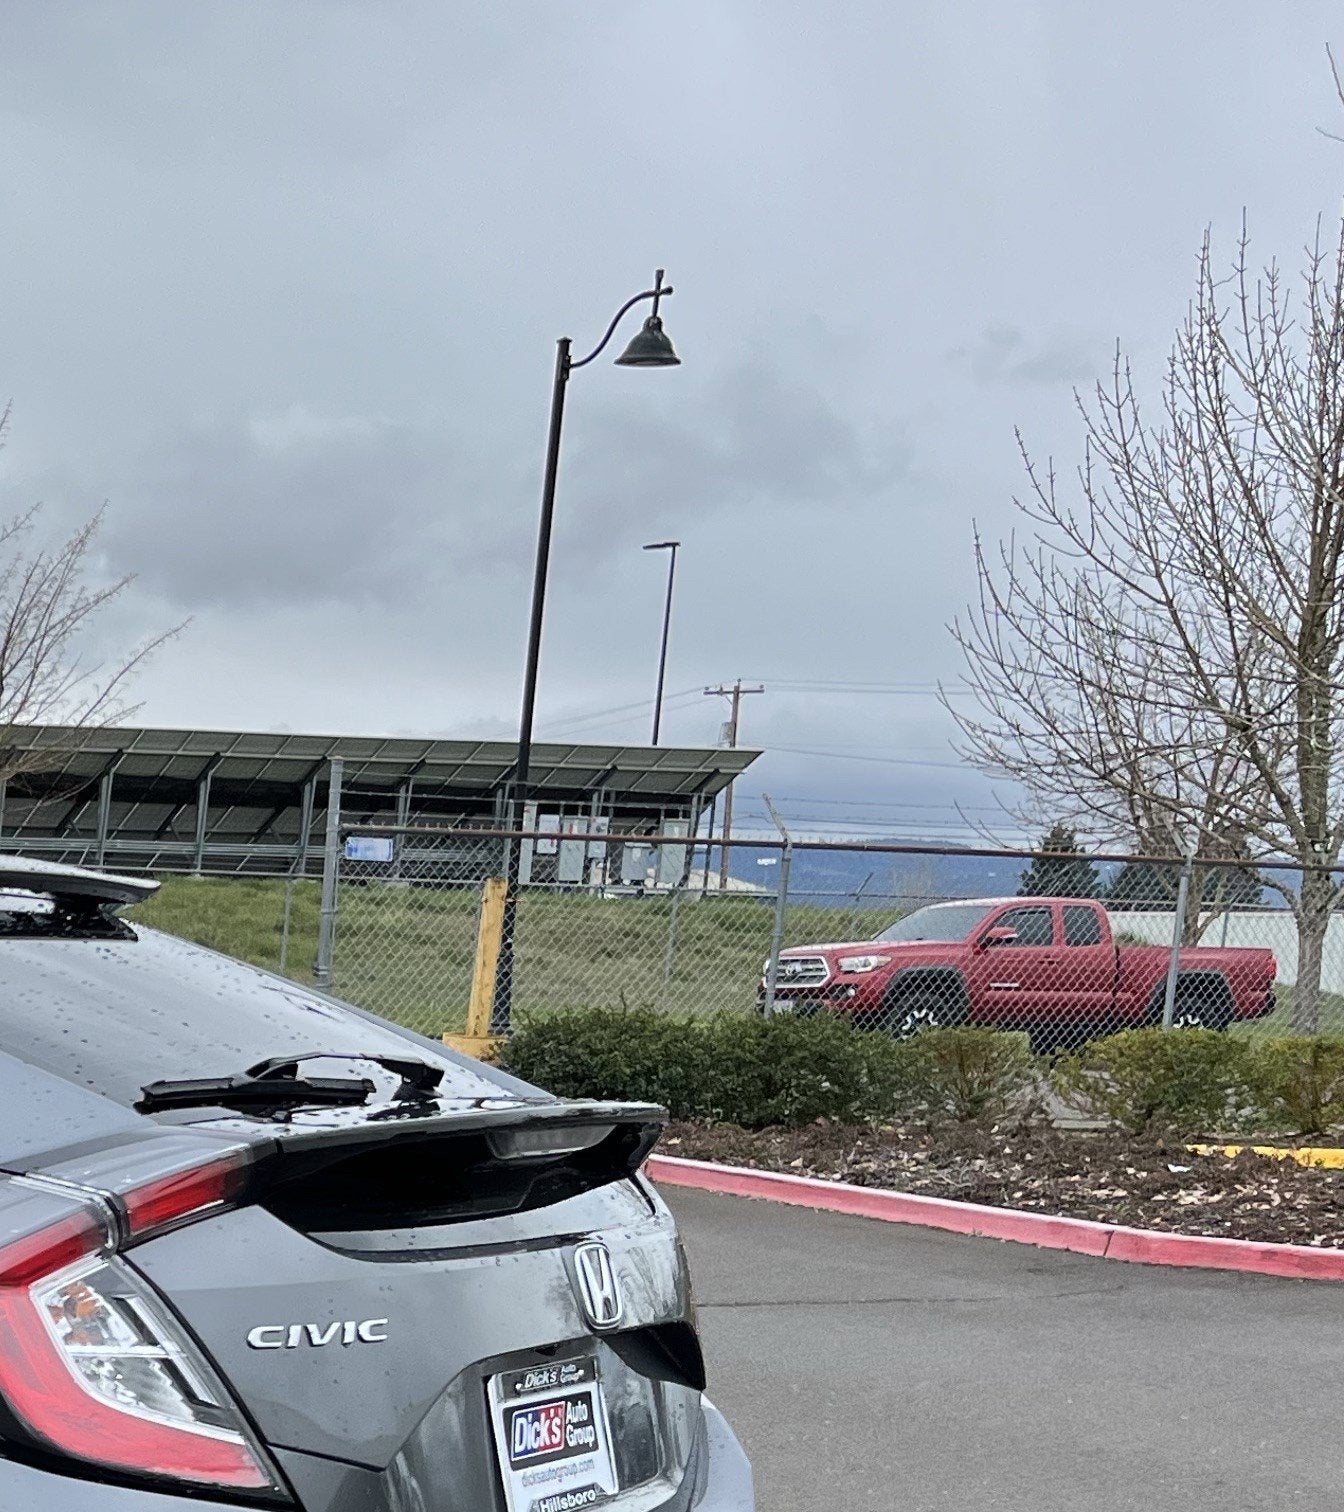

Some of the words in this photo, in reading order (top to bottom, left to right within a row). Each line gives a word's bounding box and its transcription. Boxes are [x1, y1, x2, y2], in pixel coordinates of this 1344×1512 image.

[246, 1318, 389, 1350] CIVIC
[523, 1368, 558, 1389] Dick's
[566, 1400, 589, 1424] Auto
[514, 1408, 561, 1454] Dick's
[566, 1424, 596, 1448] Group
